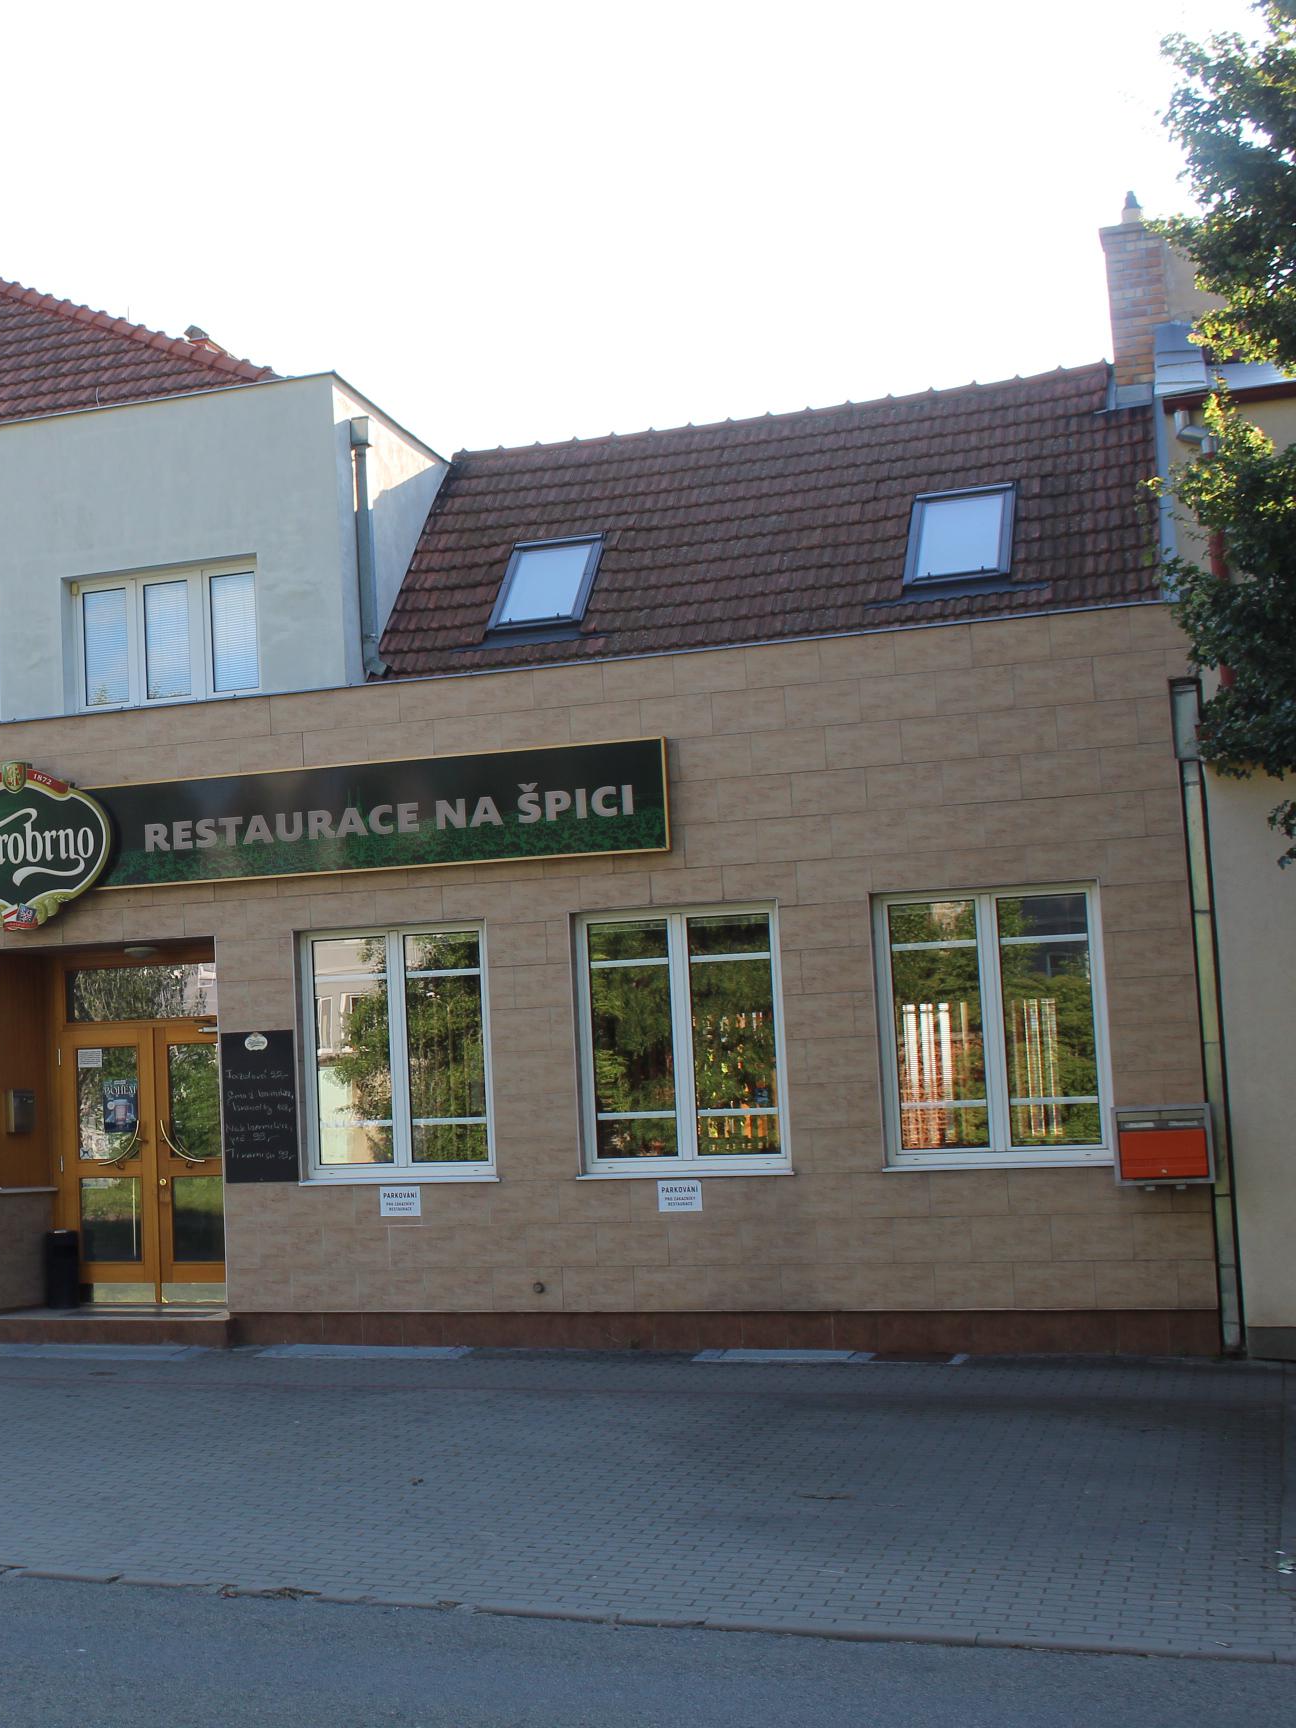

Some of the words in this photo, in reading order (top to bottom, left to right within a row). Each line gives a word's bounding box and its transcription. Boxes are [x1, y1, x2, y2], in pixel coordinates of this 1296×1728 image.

[32, 773, 53, 785] 1872
[144, 802, 420, 852] RESTAURACE
[435, 796, 503, 829] NA
[517, 783, 635, 824] ŠPICI
[661, 1184, 698, 1193] PARKOVÁNÍ
[383, 1190, 417, 1198] PARKOVÁNÍ
